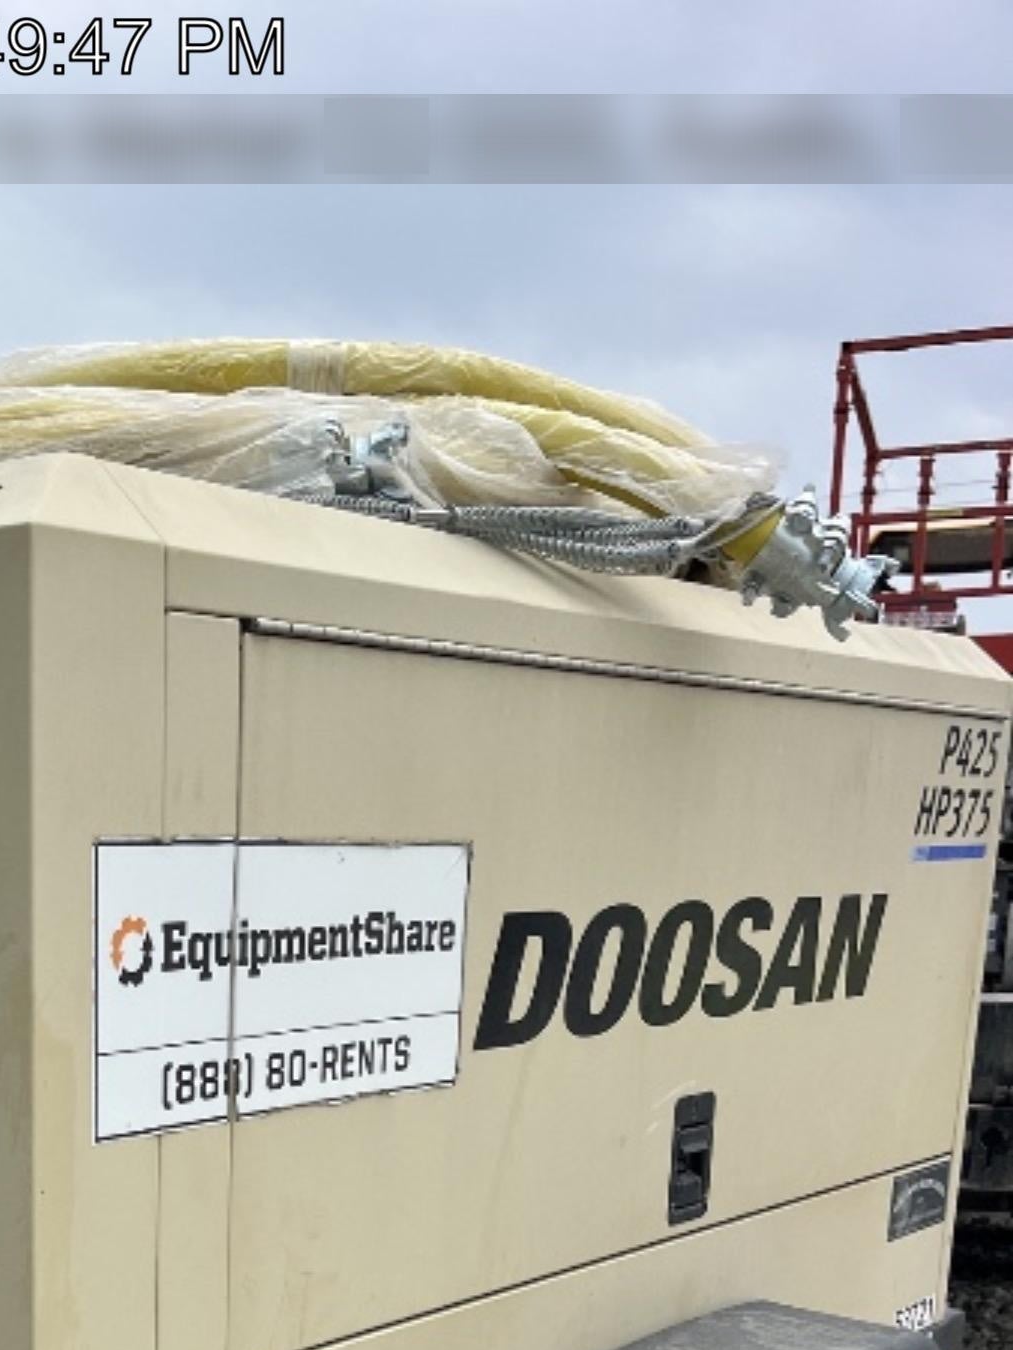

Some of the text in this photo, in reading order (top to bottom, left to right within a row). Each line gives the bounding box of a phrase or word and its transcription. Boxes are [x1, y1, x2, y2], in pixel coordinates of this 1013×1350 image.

[939, 725, 1002, 777] P425
[914, 786, 994, 838] HP375
[161, 911, 456, 982] EquipmentShare
[473, 893, 888, 1051] DOOSAN
[163, 1035, 411, 1110] (888) 80-RENTS
